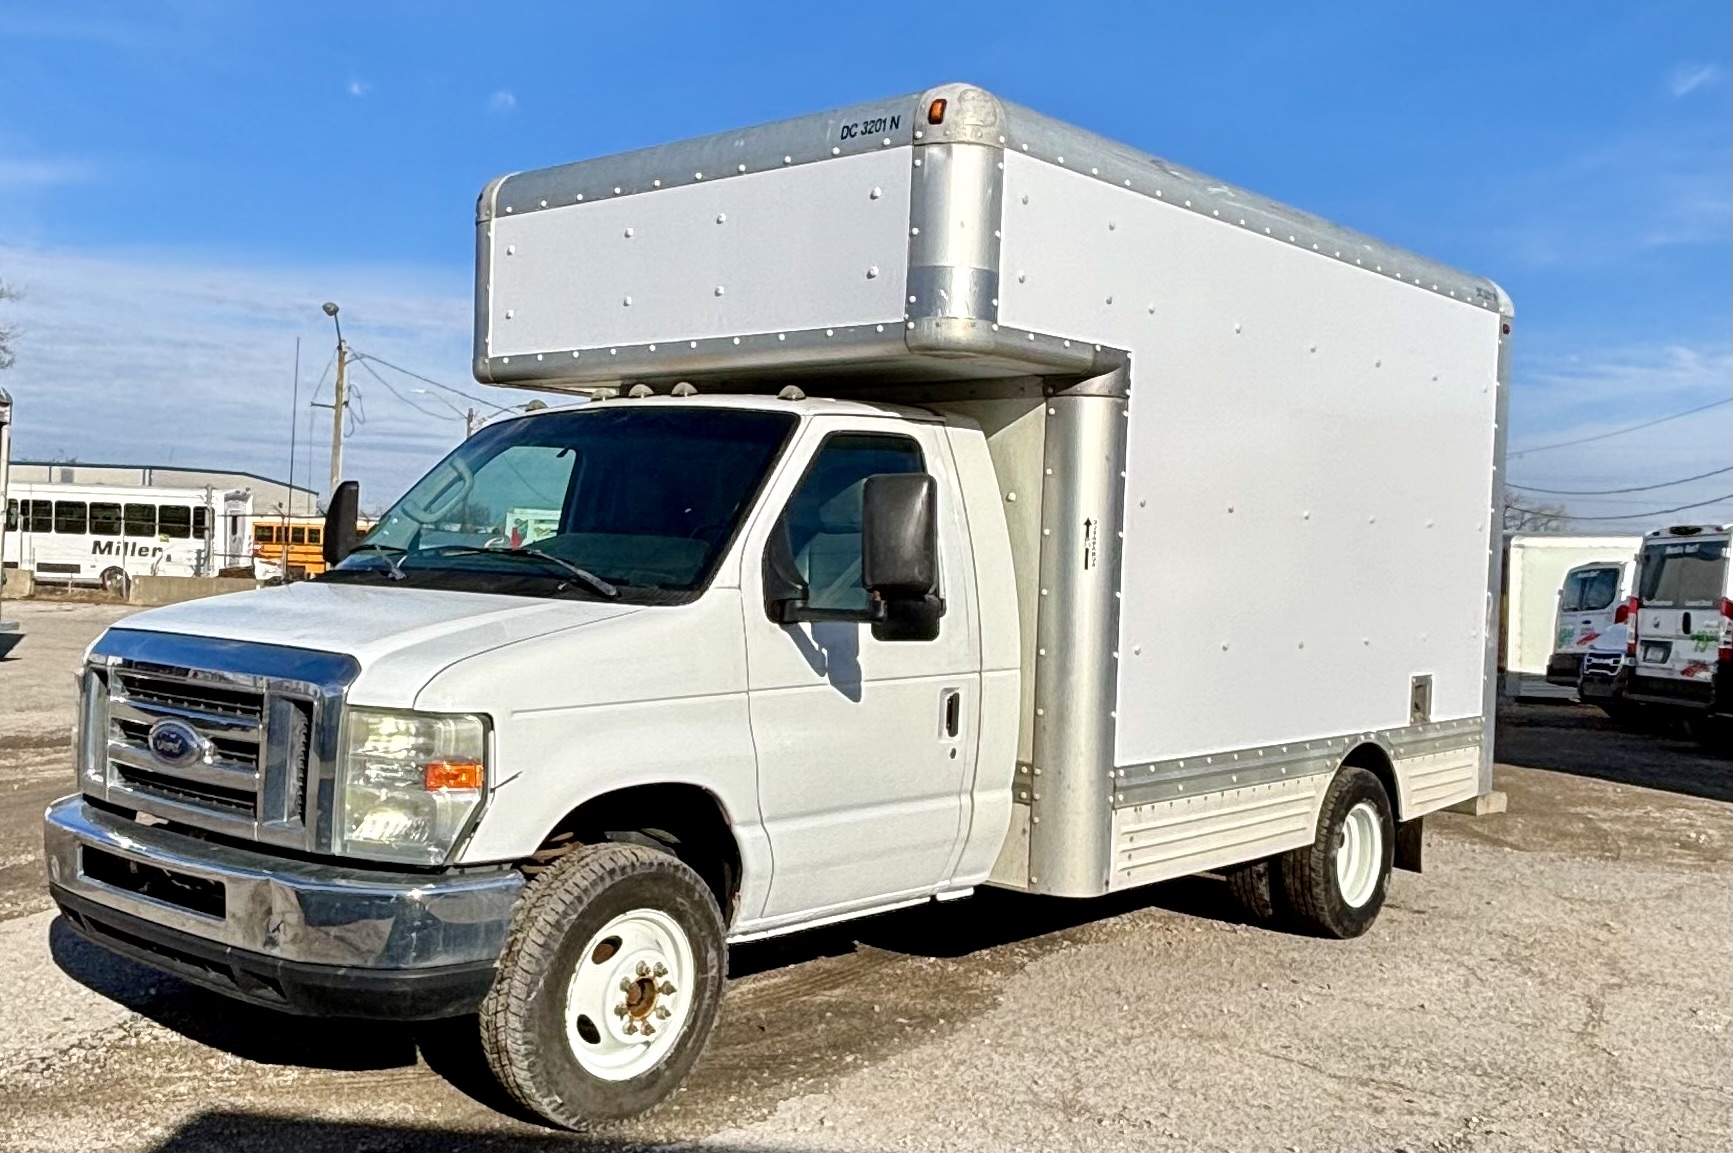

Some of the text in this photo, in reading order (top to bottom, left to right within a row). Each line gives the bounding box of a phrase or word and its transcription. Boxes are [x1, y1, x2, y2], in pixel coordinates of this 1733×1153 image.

[840, 114, 902, 141] DC 3201 N
[91, 540, 163, 558] Miller
